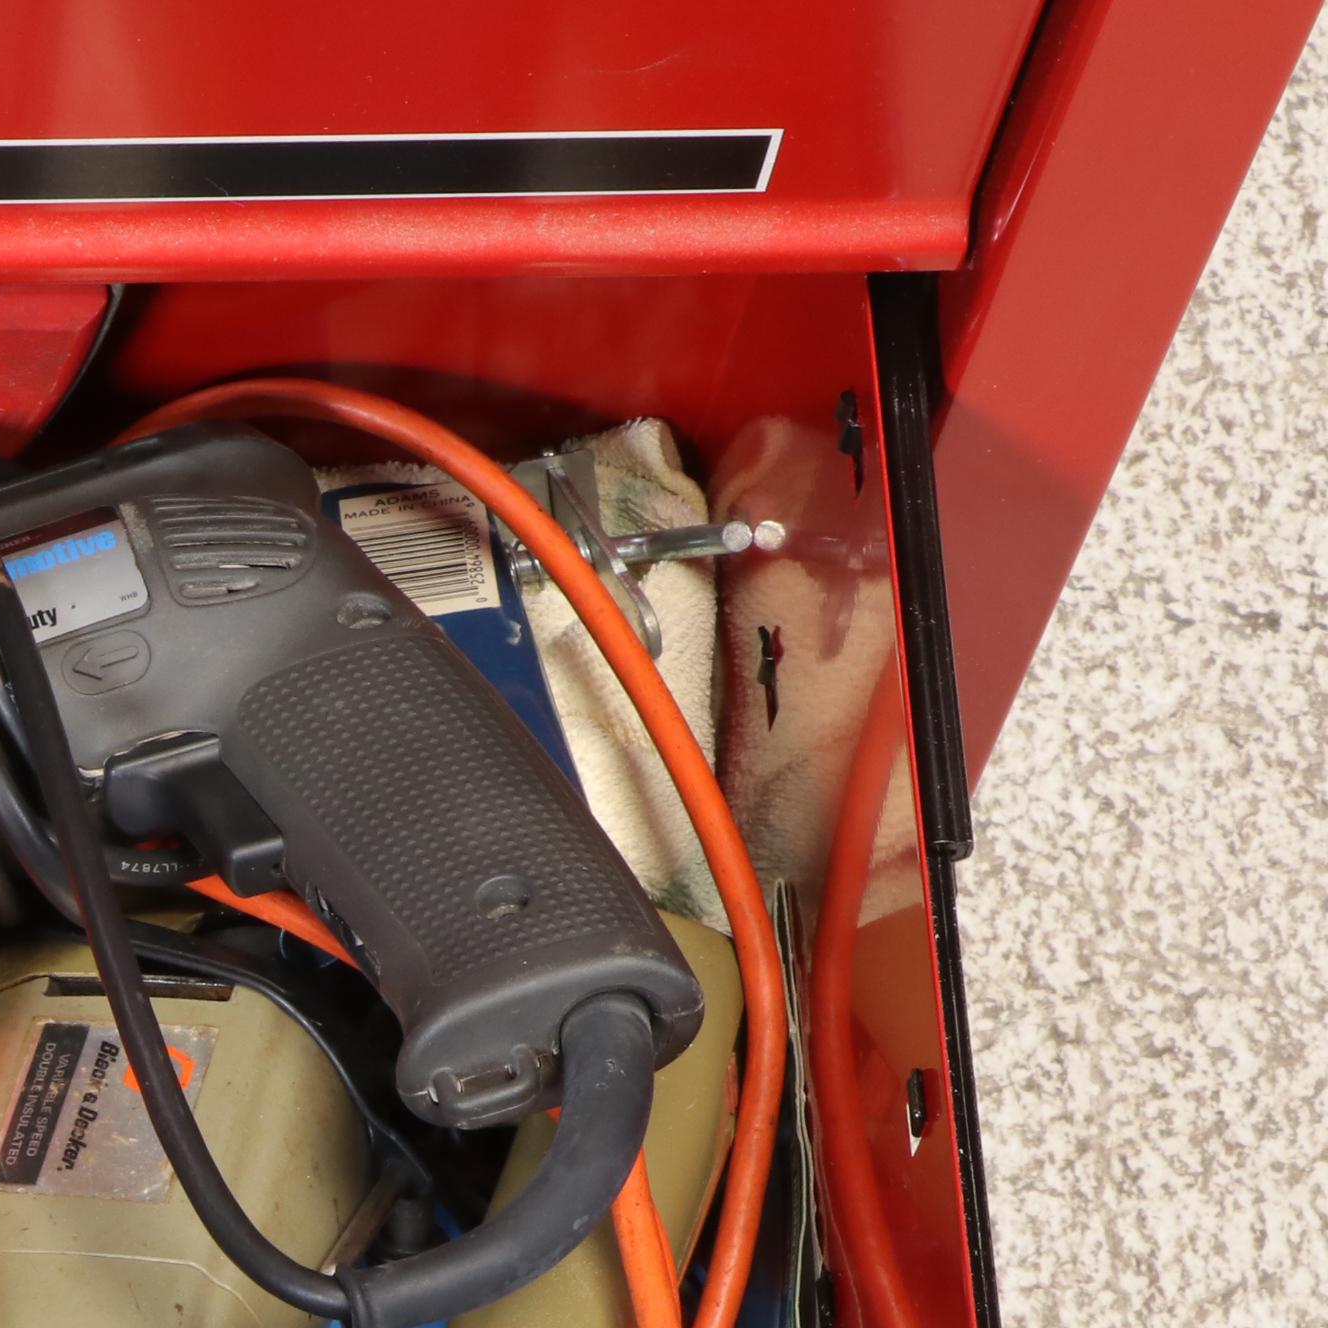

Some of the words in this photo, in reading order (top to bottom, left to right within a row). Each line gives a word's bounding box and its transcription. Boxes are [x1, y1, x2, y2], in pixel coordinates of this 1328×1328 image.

[344, 506, 392, 520] MADE
[398, 503, 415, 512] IN
[418, 494, 472, 510] CHINA
[374, 487, 442, 508] ADAMS
[3, 529, 117, 581] motive
[28, 607, 59, 631] uty
[120, 860, 179, 875] LL7874
[30, 1040, 58, 1093] DOUBLE
[4, 1092, 37, 1168] INSULATED
[25, 1115, 49, 1159] SPEED
